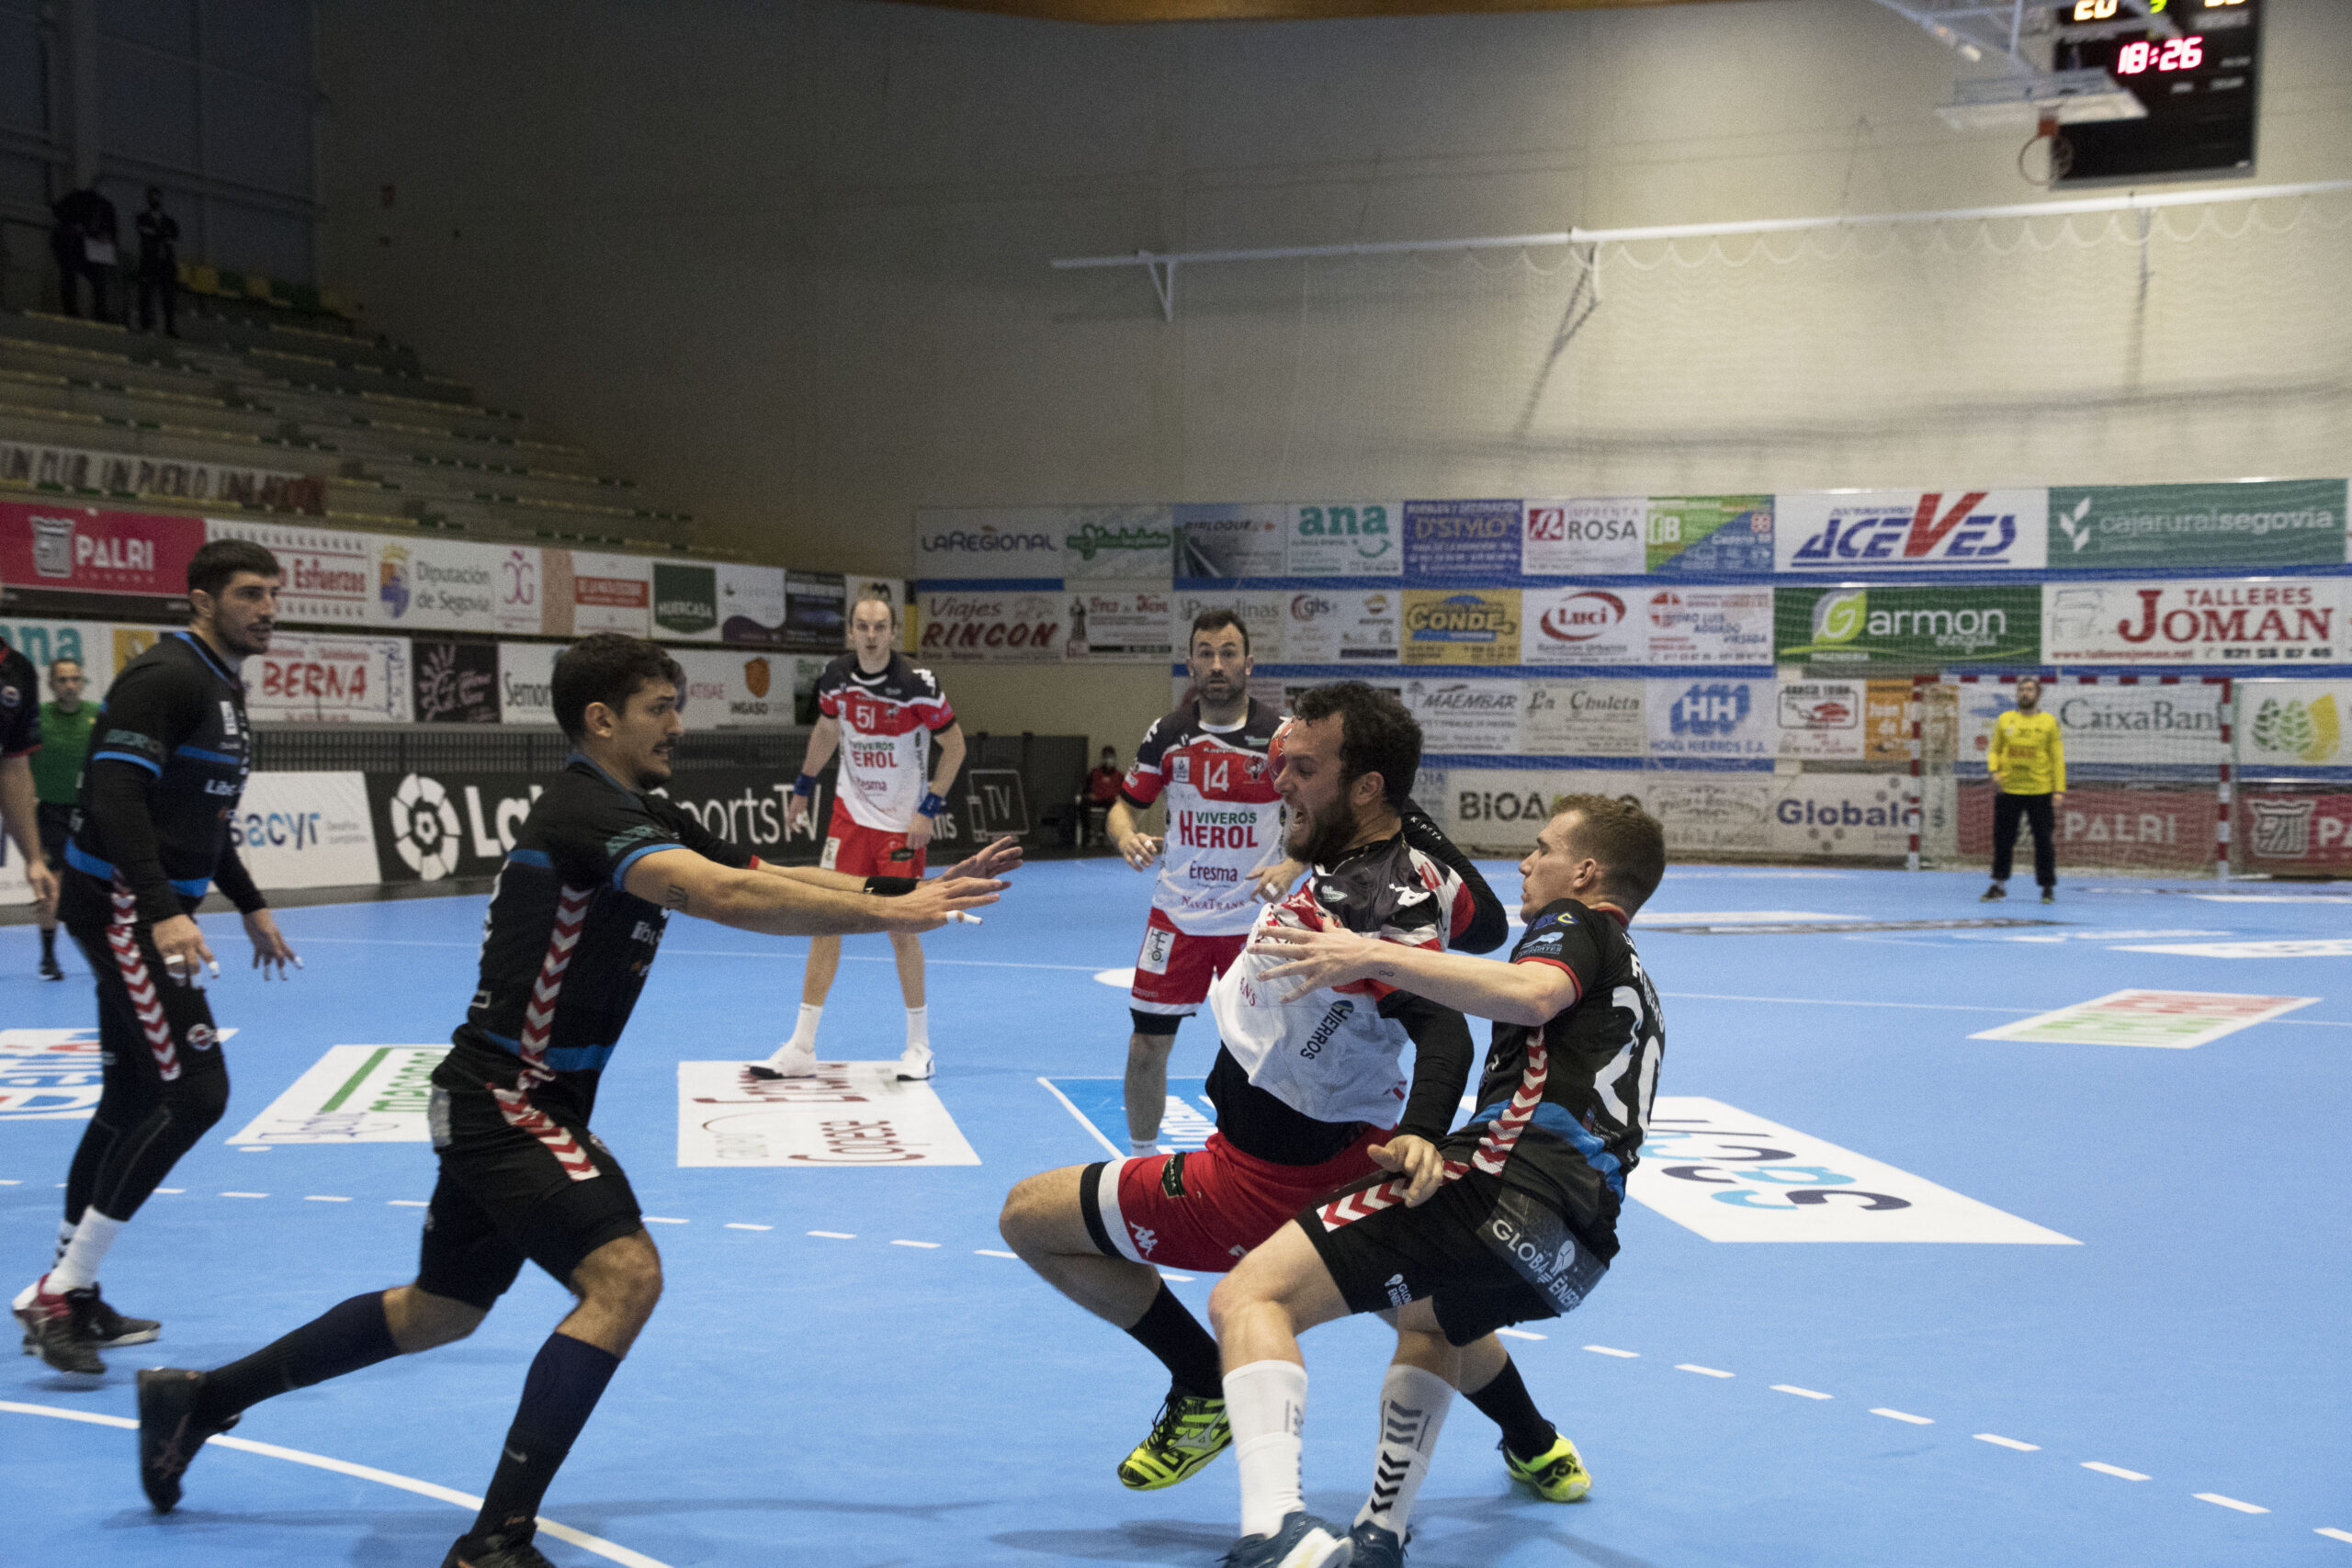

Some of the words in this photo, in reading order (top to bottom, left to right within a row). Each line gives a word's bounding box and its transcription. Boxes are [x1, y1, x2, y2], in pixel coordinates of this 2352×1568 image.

[2117, 35, 2203, 74] 18:26
[1298, 505, 1389, 536] ana
[1567, 521, 1638, 540] ROSA
[1792, 491, 2018, 558] ACEVES
[2098, 506, 2335, 536] cajaruralsegovia
[76, 534, 154, 570] PALRI
[930, 598, 1002, 621] Viajes
[2184, 587, 2313, 606] TALLERES
[1408, 604, 1514, 634] CONDE
[1868, 609, 2007, 637] armon
[2117, 590, 2335, 643] JOMAN
[922, 623, 1058, 648] RINCON
[263, 662, 368, 700] BERNA
[2060, 698, 2222, 732] CaixaBan
[1203, 760, 1229, 793] 14
[984, 784, 1011, 820] TV
[1180, 810, 1259, 849] HEROL
[1196, 811, 1258, 825] VIVEROS
[2064, 812, 2177, 843] PALRI
[1189, 861, 1238, 883] Eresma
[1300, 1007, 1351, 1060] HIERROS
